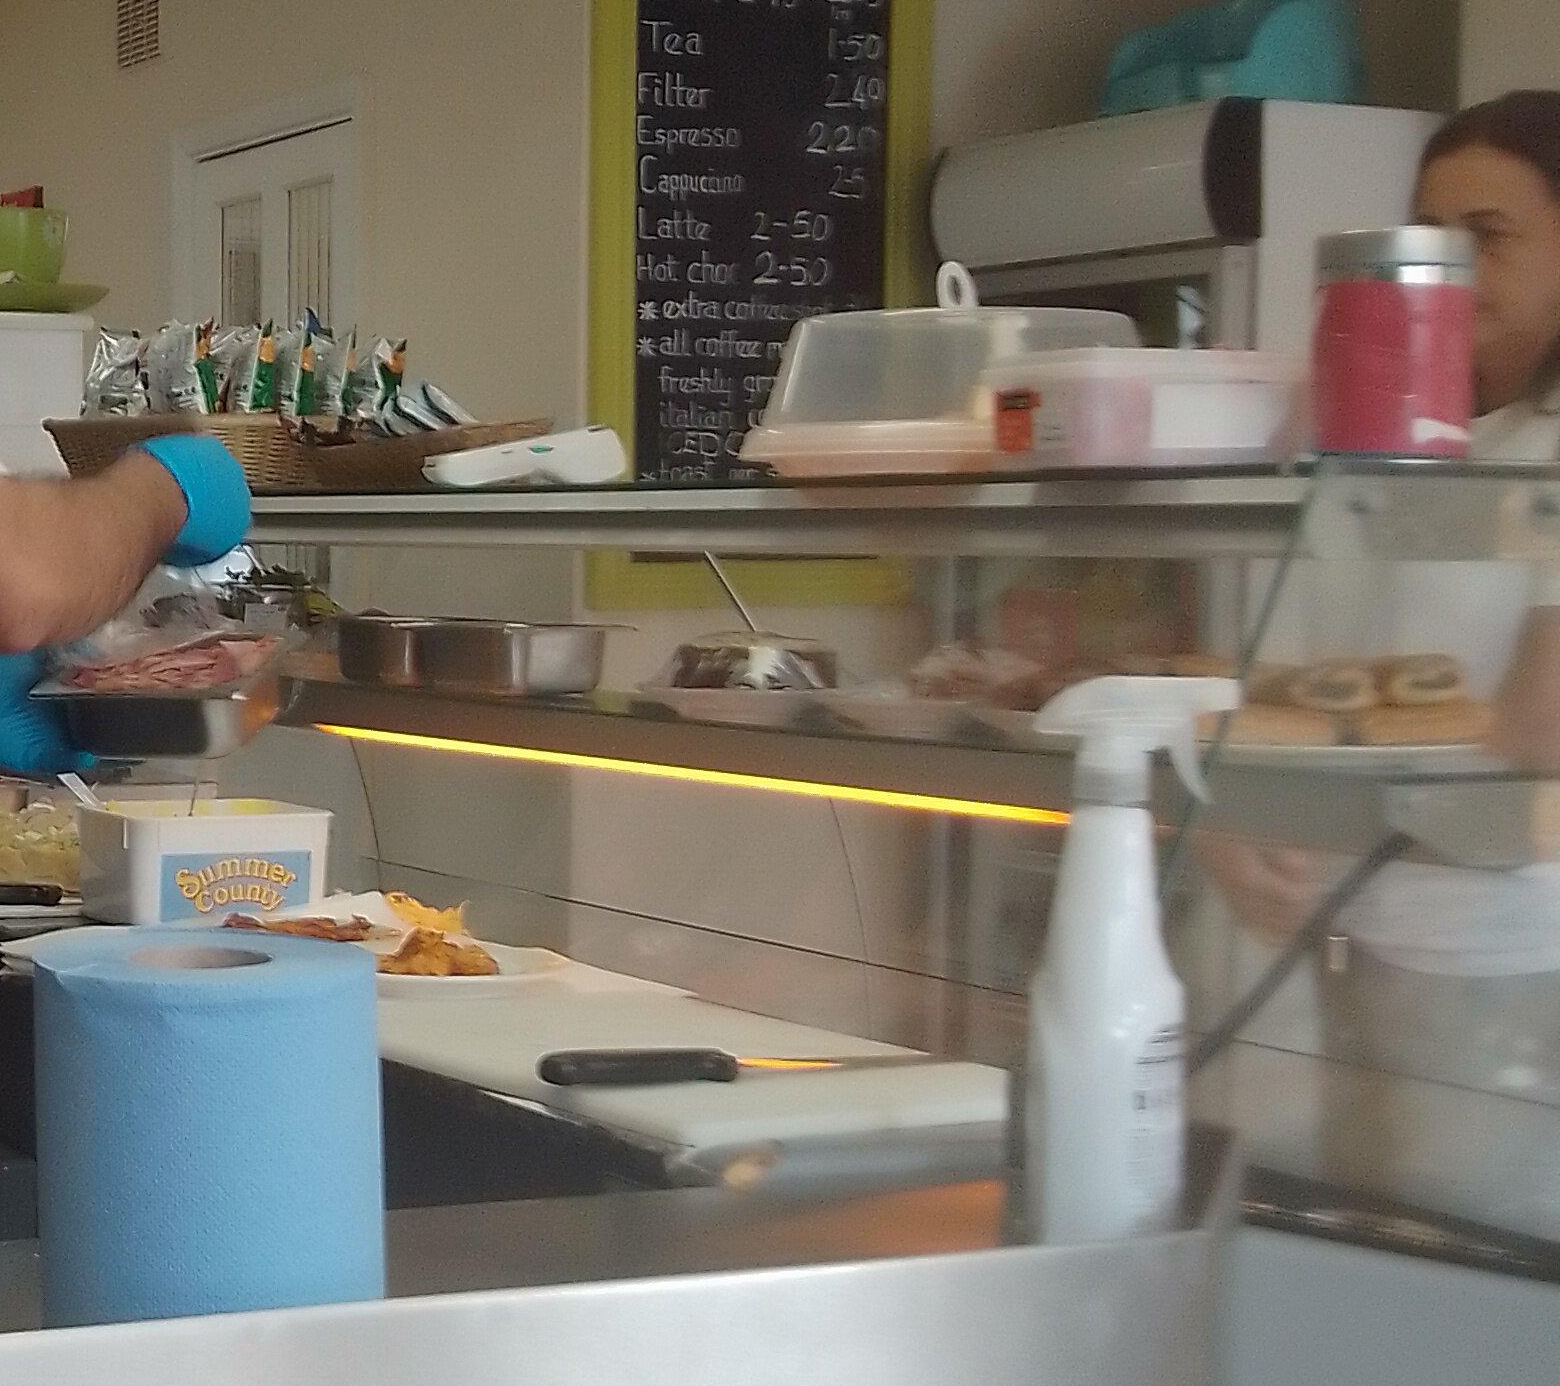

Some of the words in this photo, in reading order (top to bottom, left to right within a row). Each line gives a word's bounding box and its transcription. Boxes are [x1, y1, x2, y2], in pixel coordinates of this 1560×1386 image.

[641, 20, 703, 55] Tea
[637, 72, 713, 108] Filter
[636, 116, 739, 153] Espresso
[637, 206, 711, 242] Latte
[636, 253, 680, 283] Hot
[662, 290, 722, 320] extra
[659, 328, 691, 357] all
[175, 857, 297, 899] Summer
[194, 881, 286, 913] County
